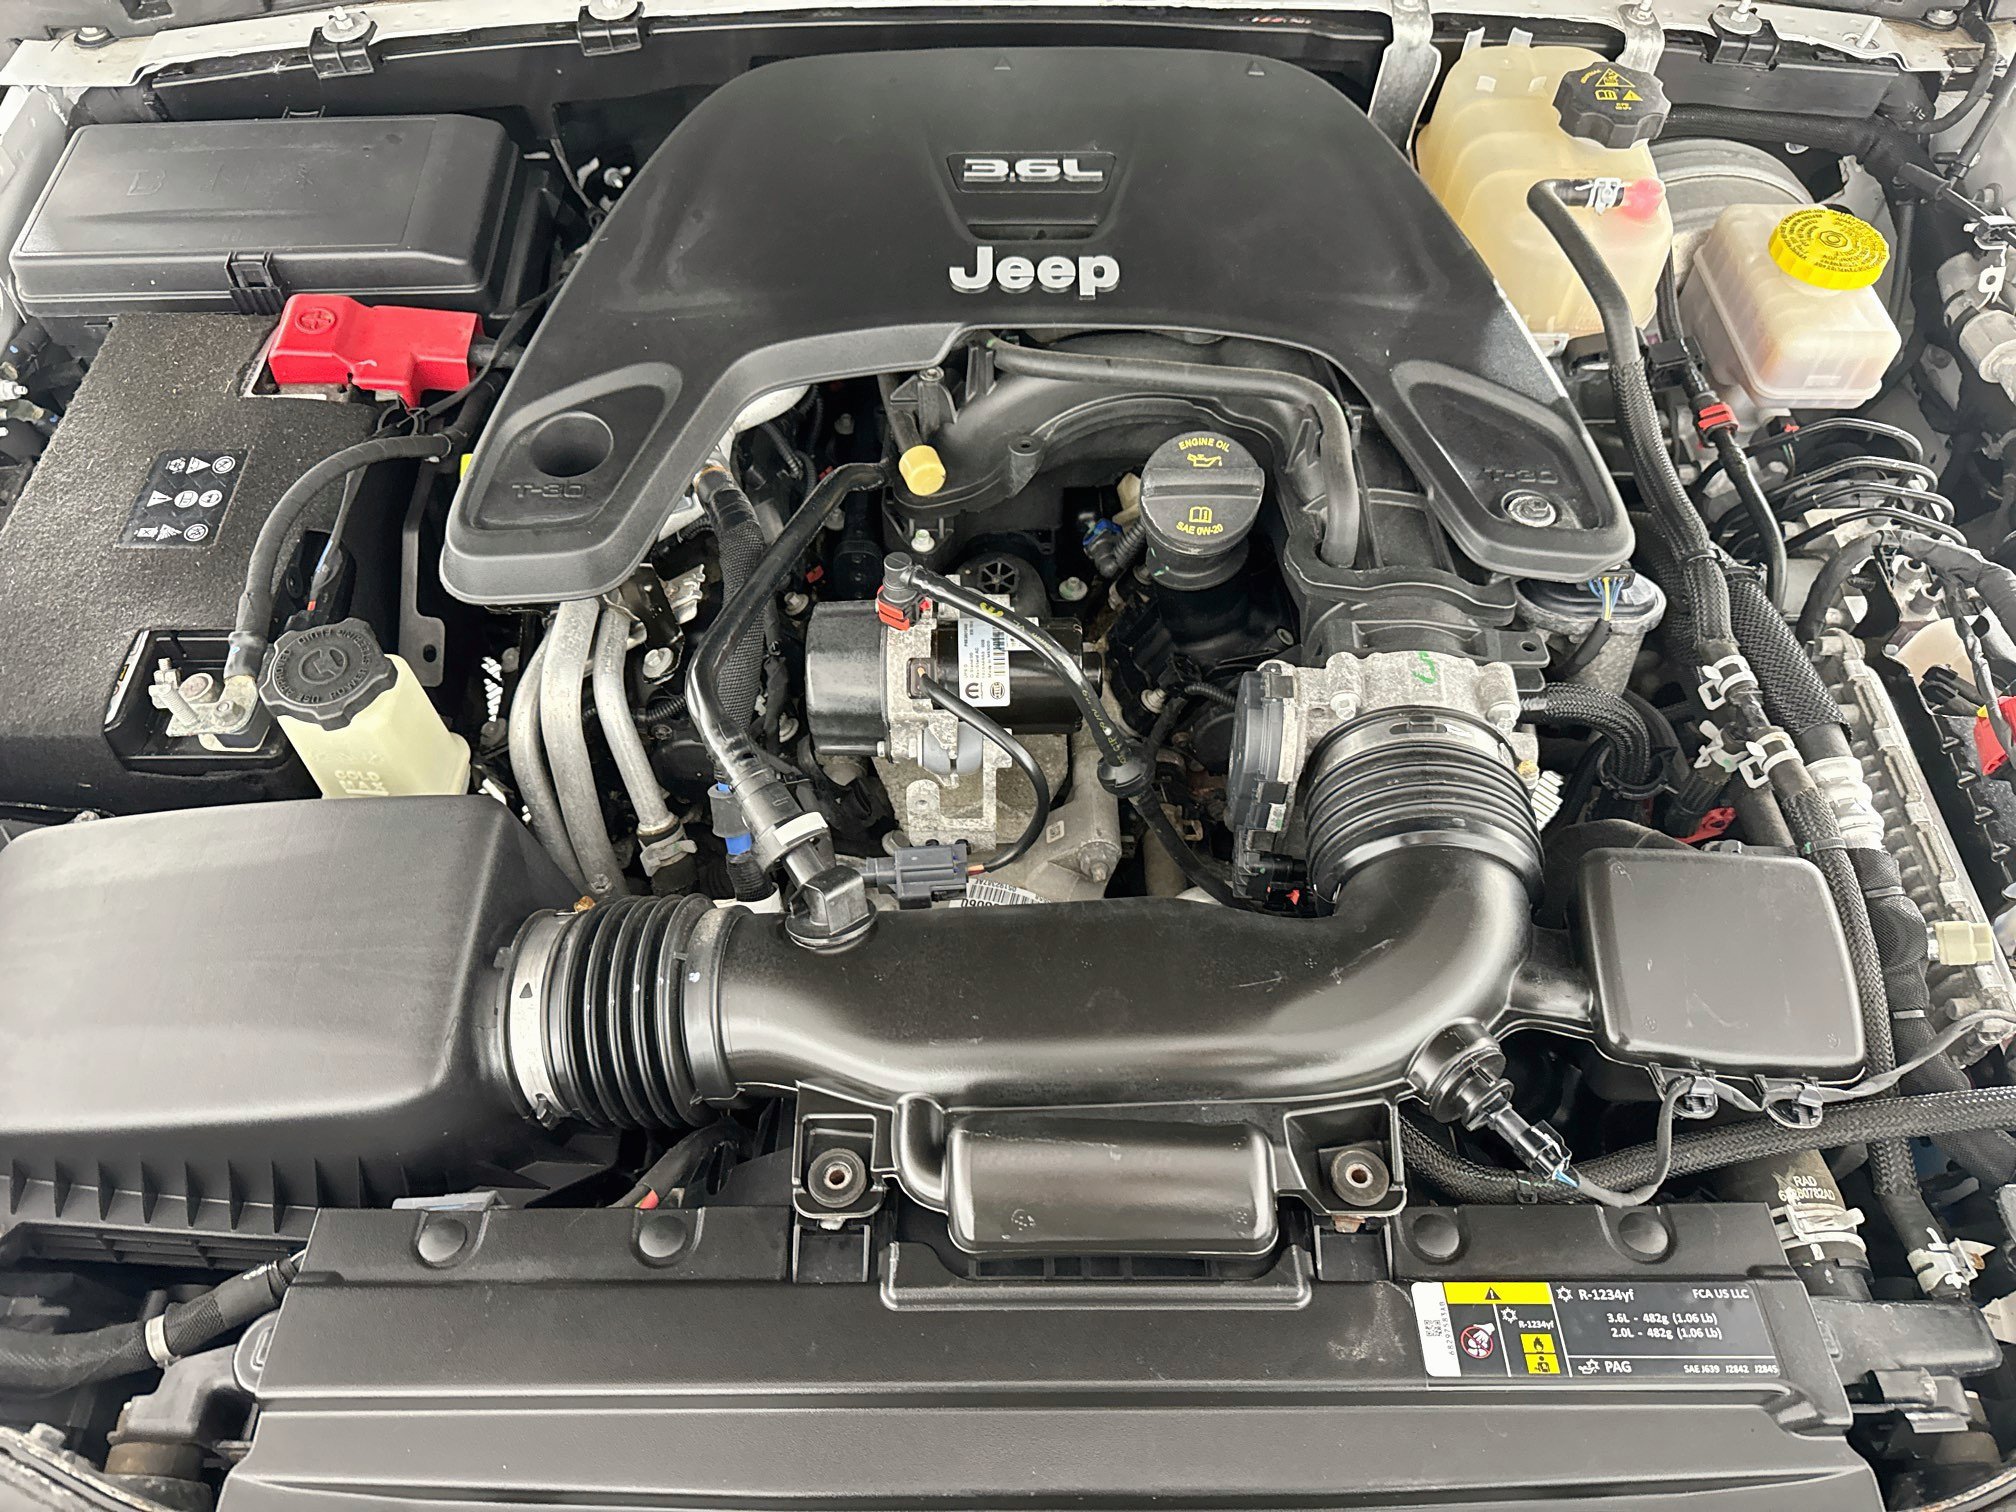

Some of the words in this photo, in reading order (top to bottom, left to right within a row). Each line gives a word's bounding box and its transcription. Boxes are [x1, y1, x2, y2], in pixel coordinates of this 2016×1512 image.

[963, 158, 1103, 182] 3.6L
[949, 246, 1120, 300] Jeep
[1178, 437, 1215, 450] ENGINE
[1216, 439, 1230, 453] OIL
[511, 483, 585, 499] T-30
[1176, 521, 1195, 535] SAE
[1196, 523, 1224, 535] 0W-20
[1792, 1175, 1818, 1187] RAD
[1577, 1288, 1635, 1303] R-1234yf
[1692, 1288, 1714, 1300] FCA
[1714, 1288, 1730, 1300] US
[1730, 1288, 1750, 1300] LLC
[1518, 1320, 1555, 1330] R-1234yf
[1606, 1312, 1630, 1324] 3.6L
[1642, 1312, 1670, 1325] 482g
[1672, 1312, 1699, 1325] (1.06
[1700, 1312, 1718, 1325] Lb)
[1610, 1327, 1635, 1338] 2.0L
[1646, 1327, 1674, 1340] 482g
[1676, 1327, 1704, 1340] (1.06
[1704, 1327, 1723, 1340] Lb)
[1604, 1360, 1632, 1373] PAG
[1683, 1364, 1700, 1374] SAE
[1701, 1364, 1720, 1374] J639
[1725, 1364, 1750, 1374] J2842
